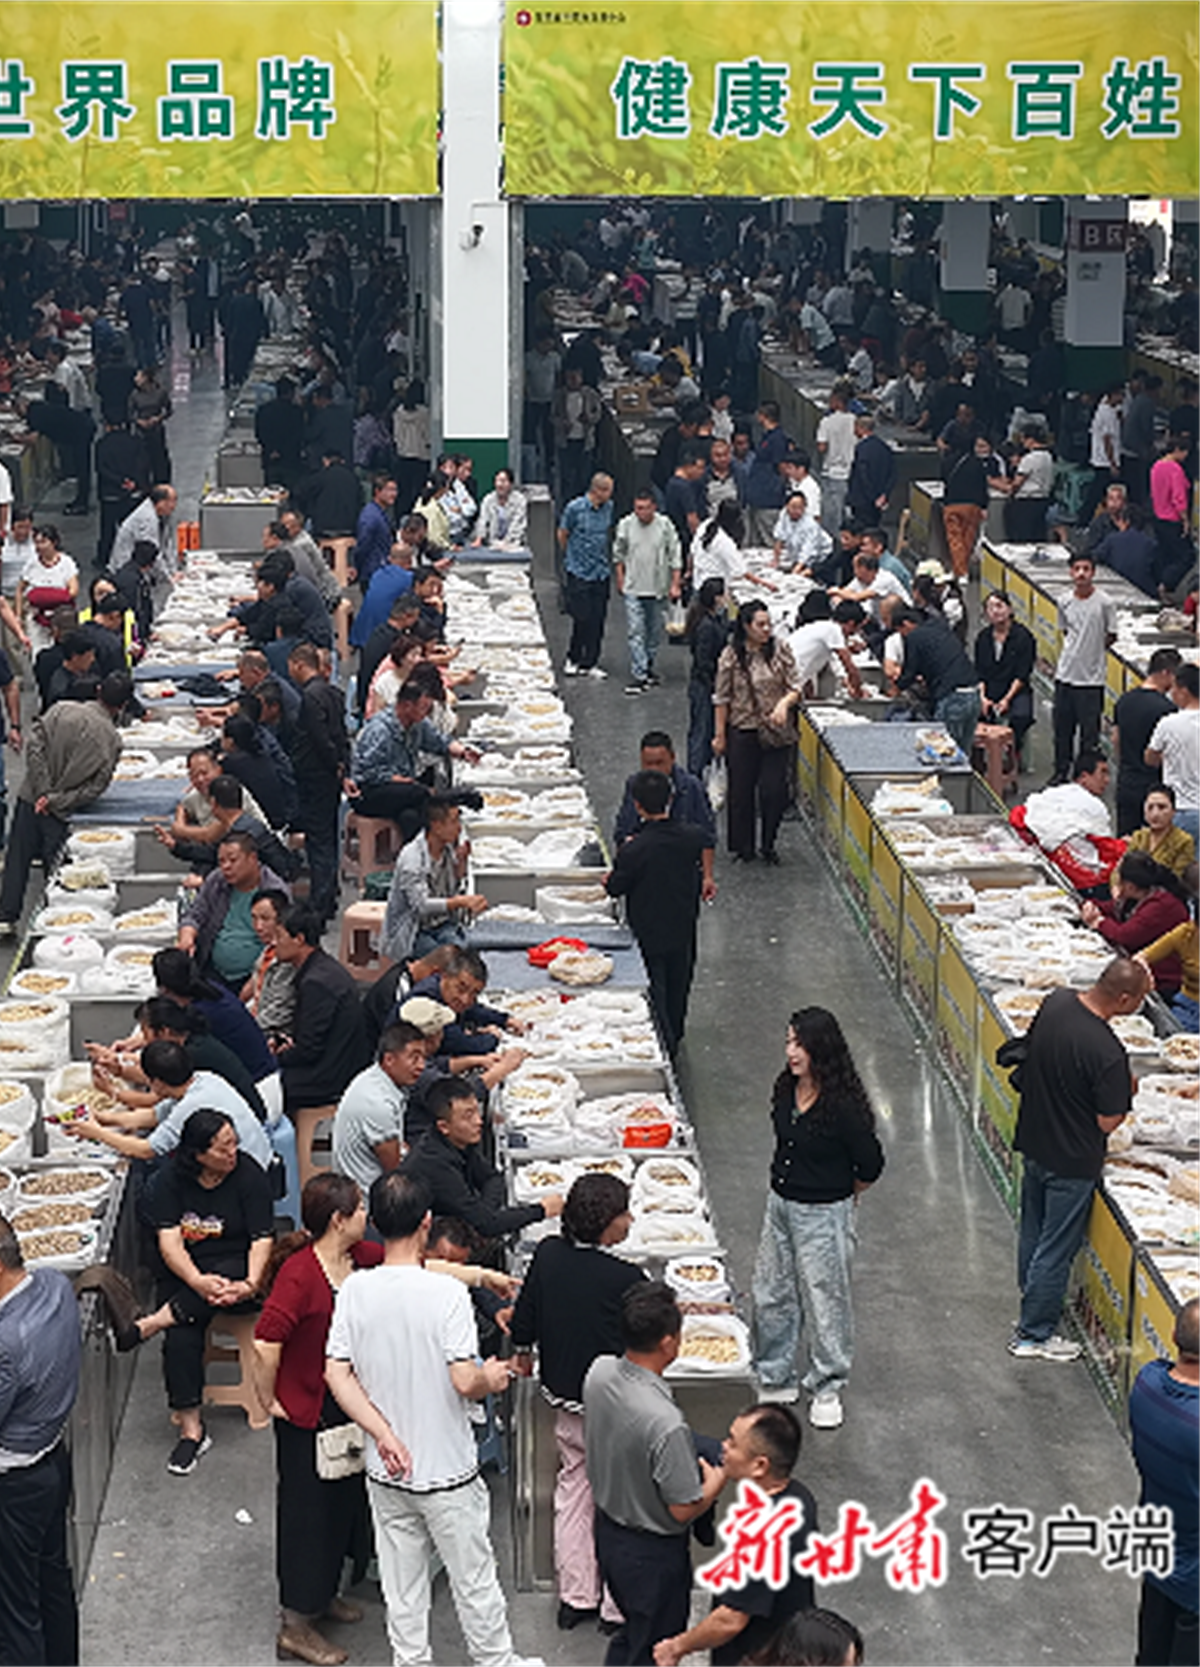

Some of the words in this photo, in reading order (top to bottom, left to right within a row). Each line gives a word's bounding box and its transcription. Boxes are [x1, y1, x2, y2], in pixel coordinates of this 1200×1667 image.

[611, 56, 1182, 140] 健康天下百姓
